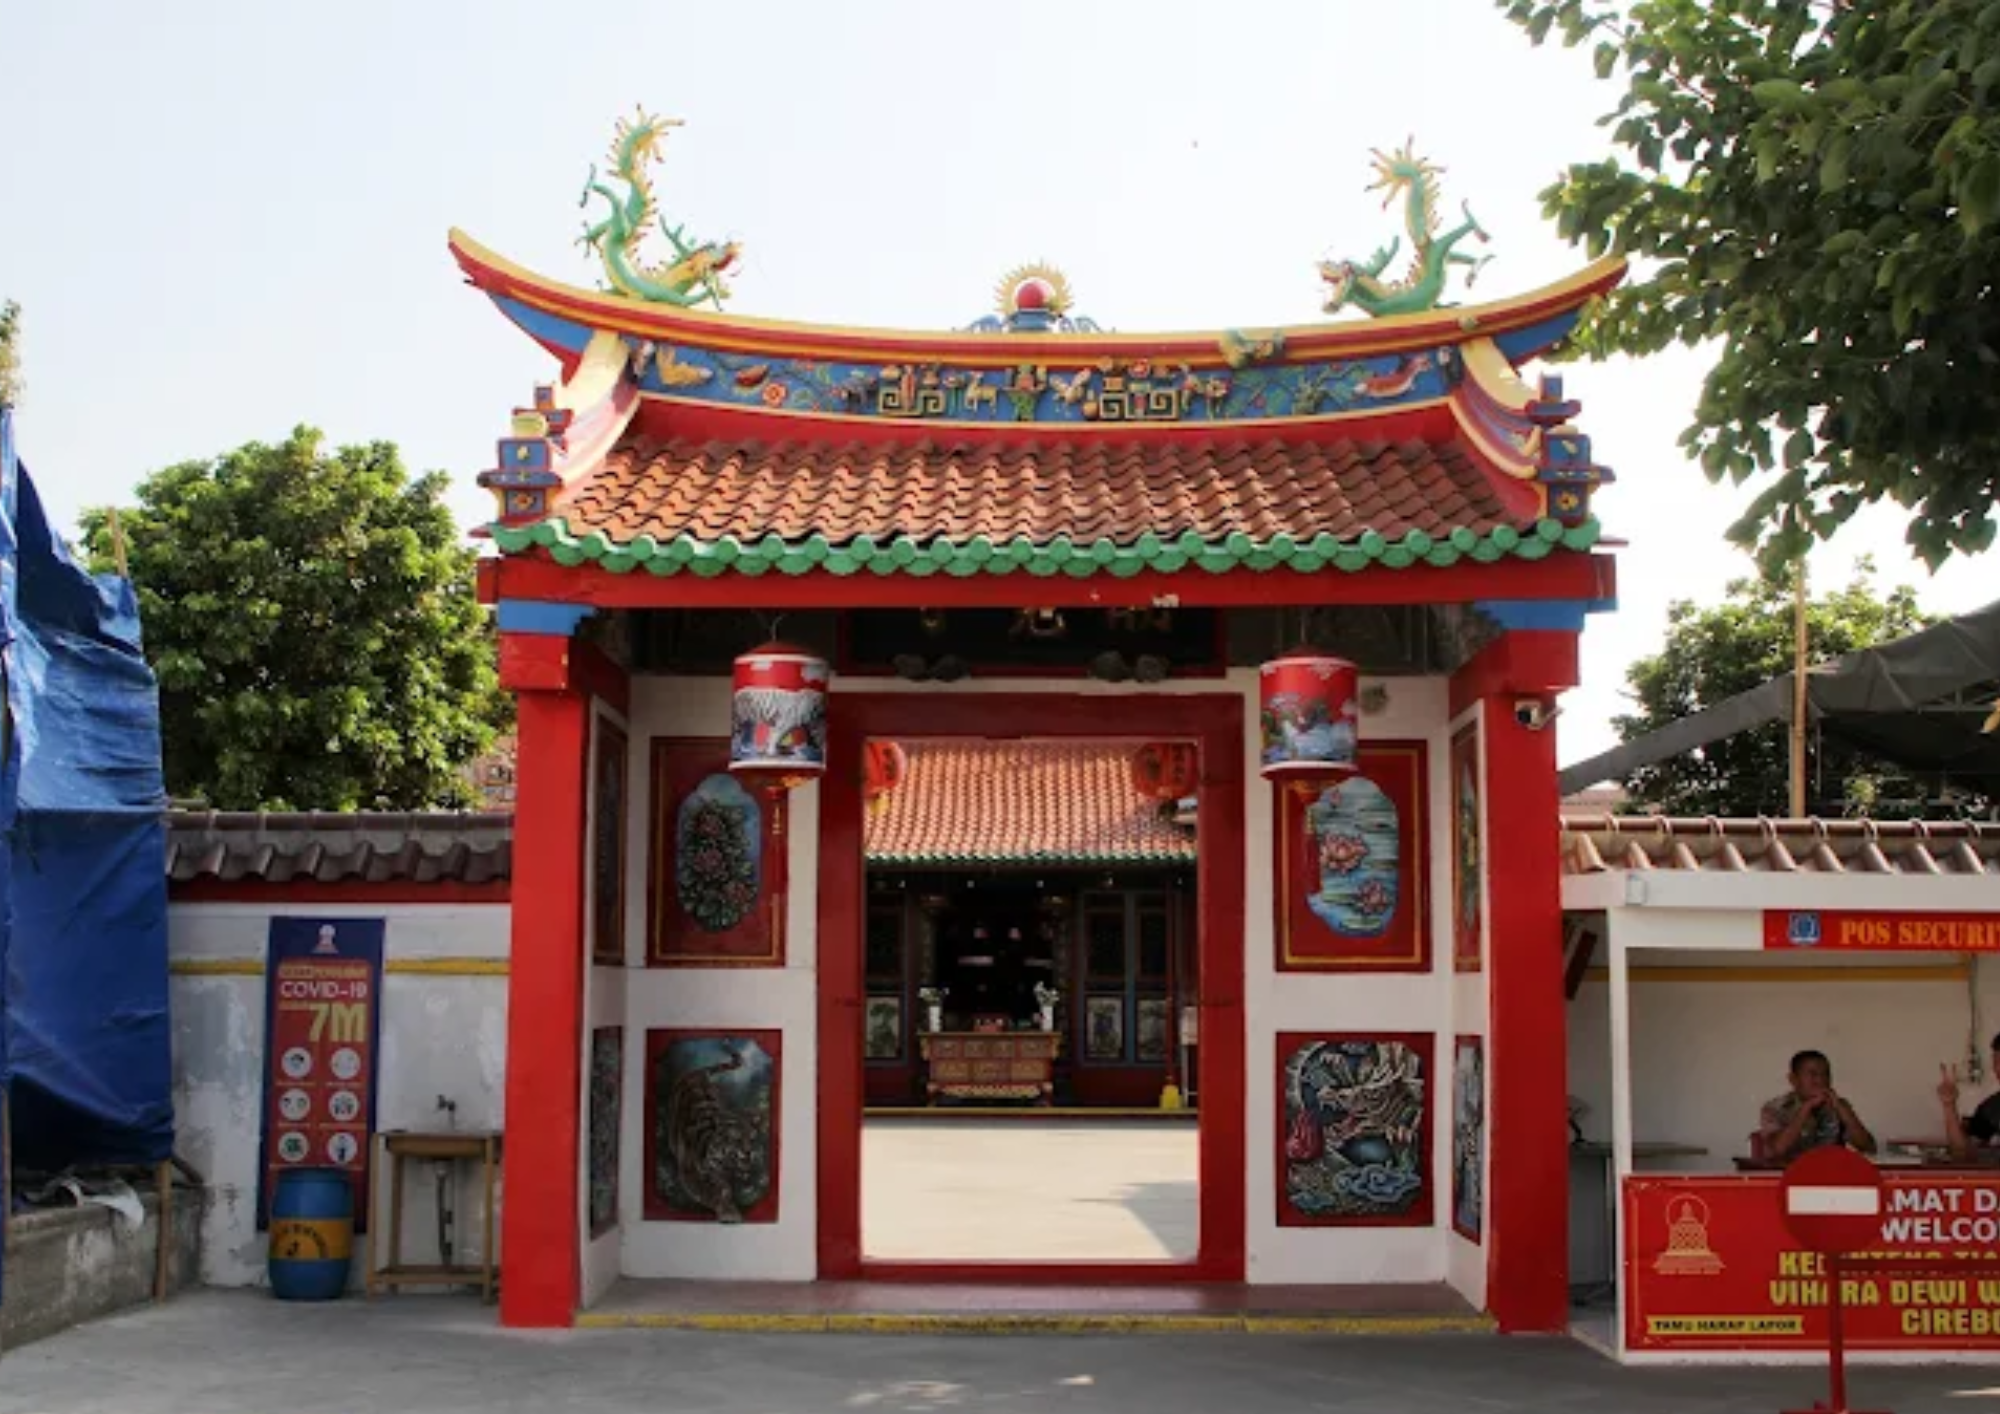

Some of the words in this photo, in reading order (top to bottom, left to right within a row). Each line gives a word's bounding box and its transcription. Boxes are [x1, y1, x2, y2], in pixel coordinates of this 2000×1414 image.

[1840, 920, 1890, 945] POS
[1898, 920, 2000, 947] SECURI
[280, 981, 367, 998] COVID-19
[309, 1003, 366, 1042] 7M
[1886, 1188, 1965, 1213] MAT
[1881, 1217, 2000, 1243] WELCO
[1890, 1280, 1967, 1306] DEWI
